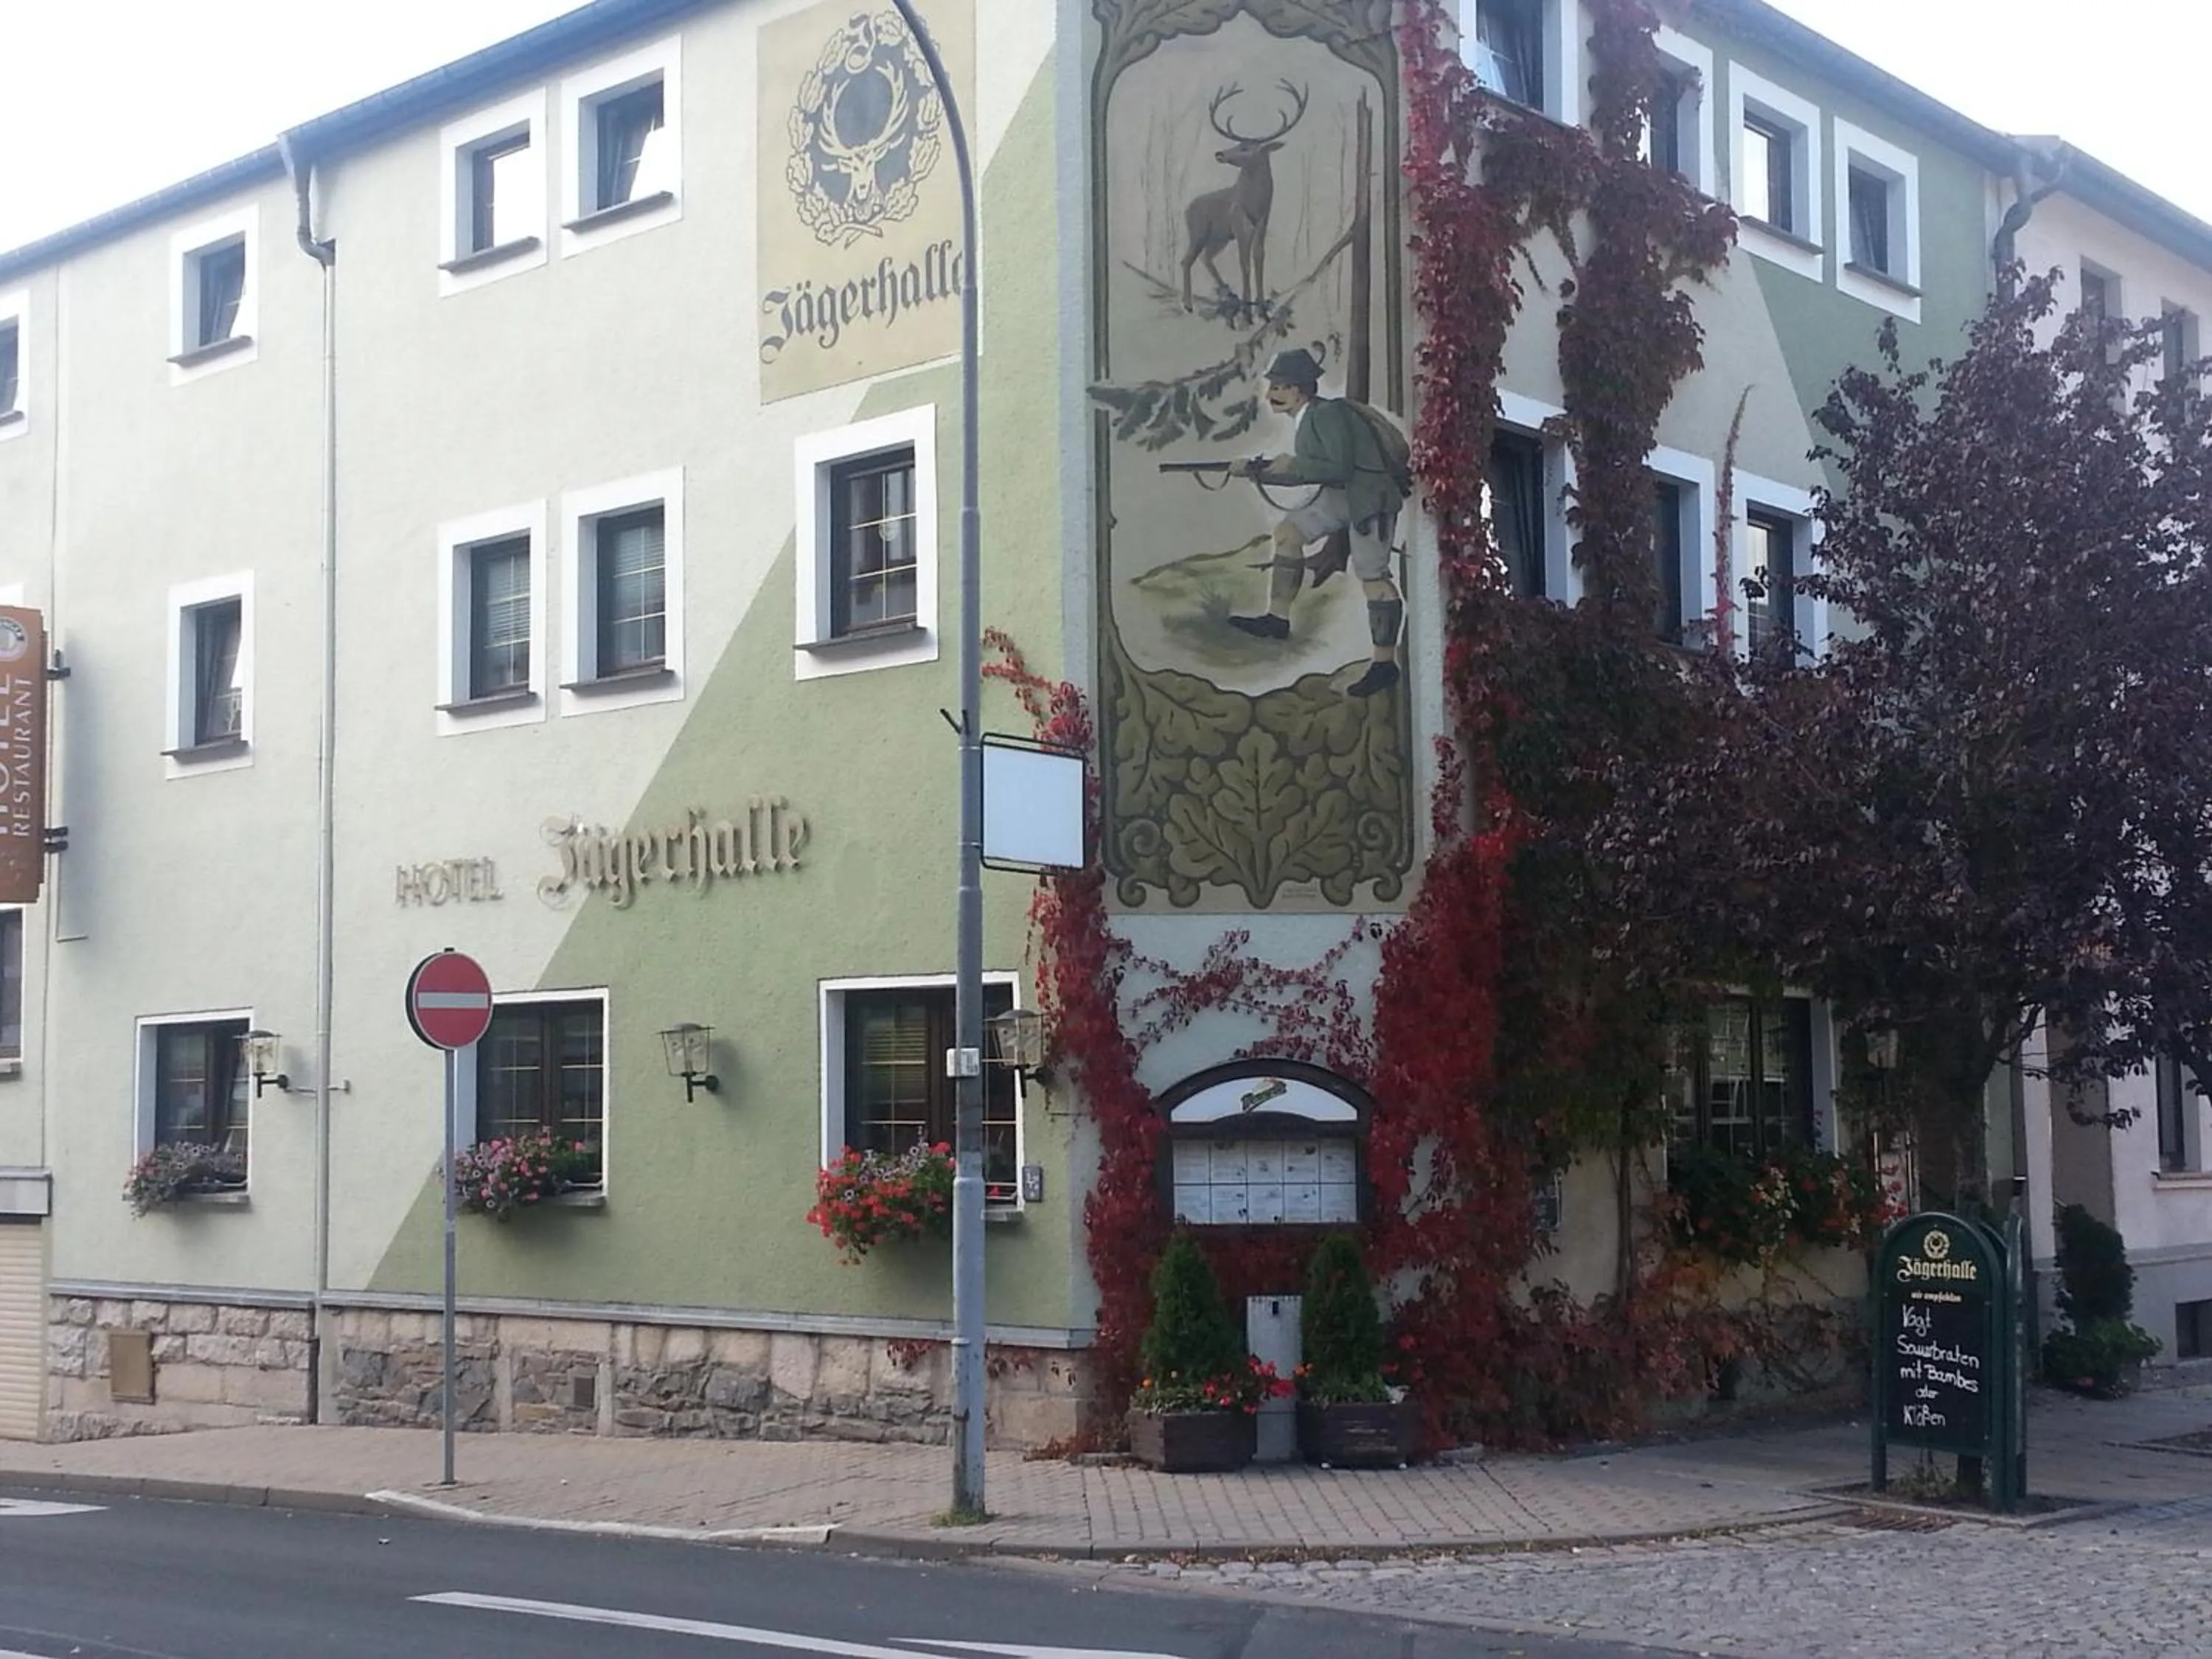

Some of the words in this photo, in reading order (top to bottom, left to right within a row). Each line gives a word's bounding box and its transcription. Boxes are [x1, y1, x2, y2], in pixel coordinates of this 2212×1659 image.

[394, 856, 505, 908] HOTEL
[537, 791, 808, 911] Jägerhalle
[1897, 1256, 1977, 1282] Jägerhalle
[1900, 1359, 1922, 1379] mit
[1924, 1364, 1978, 1393] Bambes
